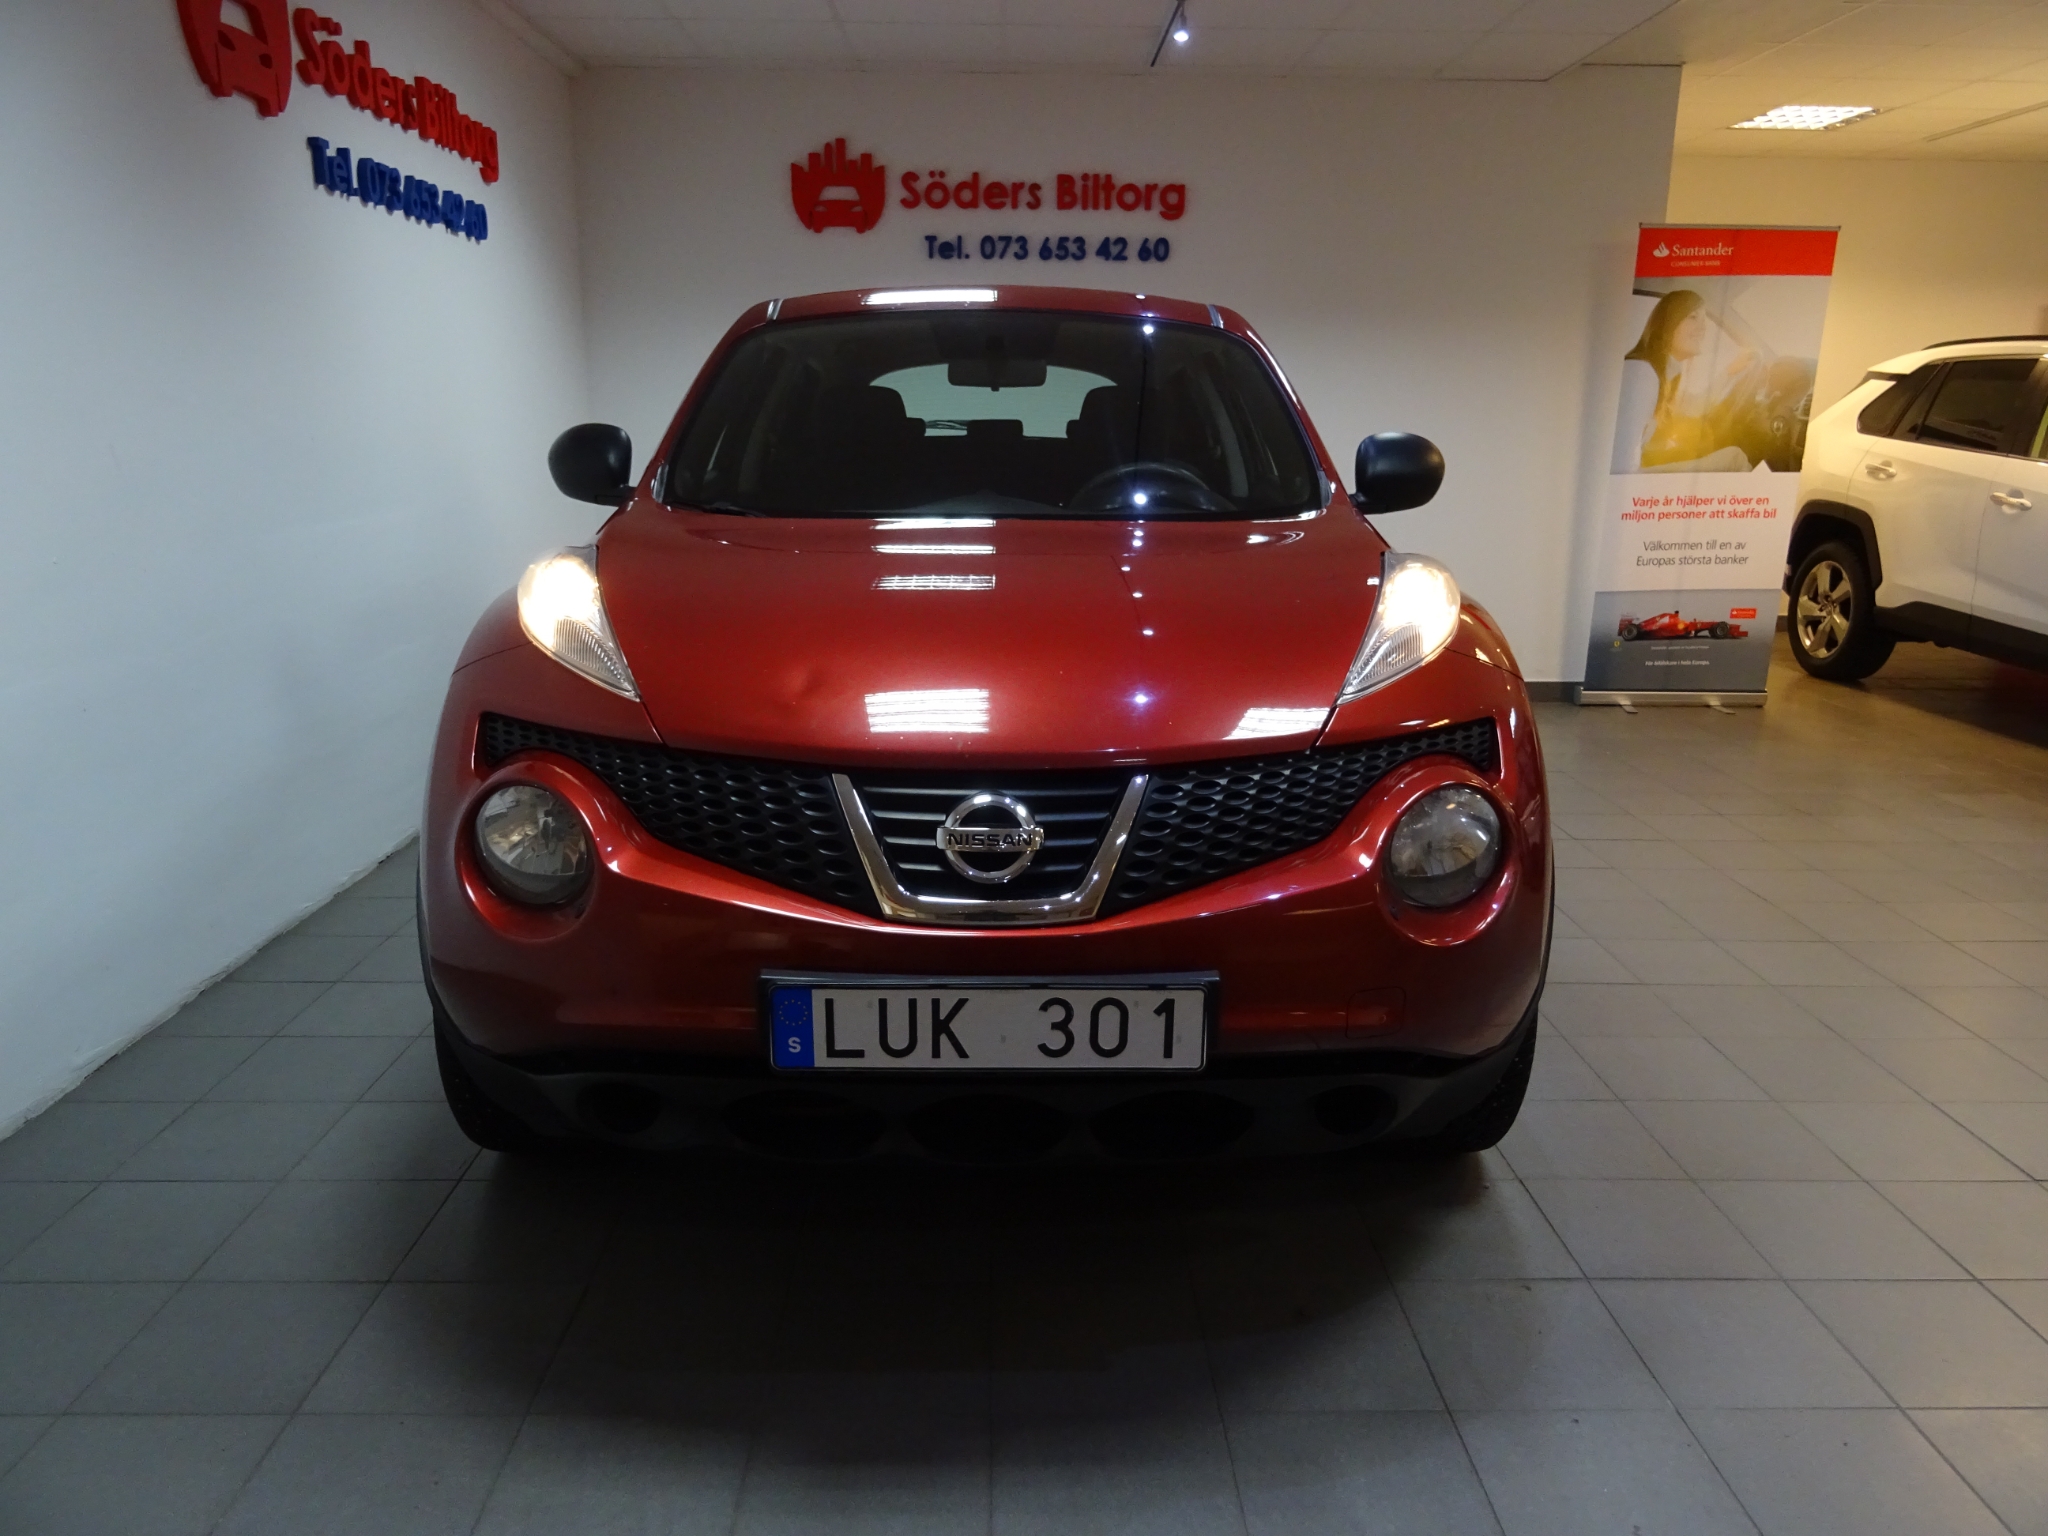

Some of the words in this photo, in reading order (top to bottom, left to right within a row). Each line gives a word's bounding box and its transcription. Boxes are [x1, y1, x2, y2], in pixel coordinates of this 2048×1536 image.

[293, 8, 417, 130] Söders
[414, 76, 499, 183] Biltorg
[900, 170, 1042, 210] Söders
[1056, 172, 1186, 221] Biltorg
[924, 234, 970, 260] Tel.
[979, 235, 1029, 261] 073
[1038, 236, 1087, 261] 653
[1095, 236, 1129, 262] 42
[1137, 237, 1171, 262] 60
[1671, 242, 1734, 257] Santander
[1632, 497, 1660, 509] Varje
[1662, 496, 1674, 507] år
[1676, 495, 1714, 508] hjälper
[1717, 495, 1727, 506] vi
[1729, 495, 1754, 506] över
[1755, 497, 1770, 506] en
[1621, 510, 1655, 523] miljon
[1657, 510, 1707, 522] personer
[1708, 509, 1725, 519] att
[1727, 508, 1760, 519] skaffa
[1763, 508, 1777, 519] bil
[1643, 540, 1703, 552] Välkommen
[1705, 539, 1718, 550] till
[1719, 542, 1732, 551] en
[1734, 542, 1747, 550] av
[1636, 555, 1676, 568] Europas
[1678, 554, 1712, 566] största
[1714, 554, 1749, 565] banker
[947, 832, 1032, 847] NISSAN
[824, 997, 971, 1060] LUK
[1036, 996, 1176, 1060] 301
[788, 1036, 802, 1053] S
